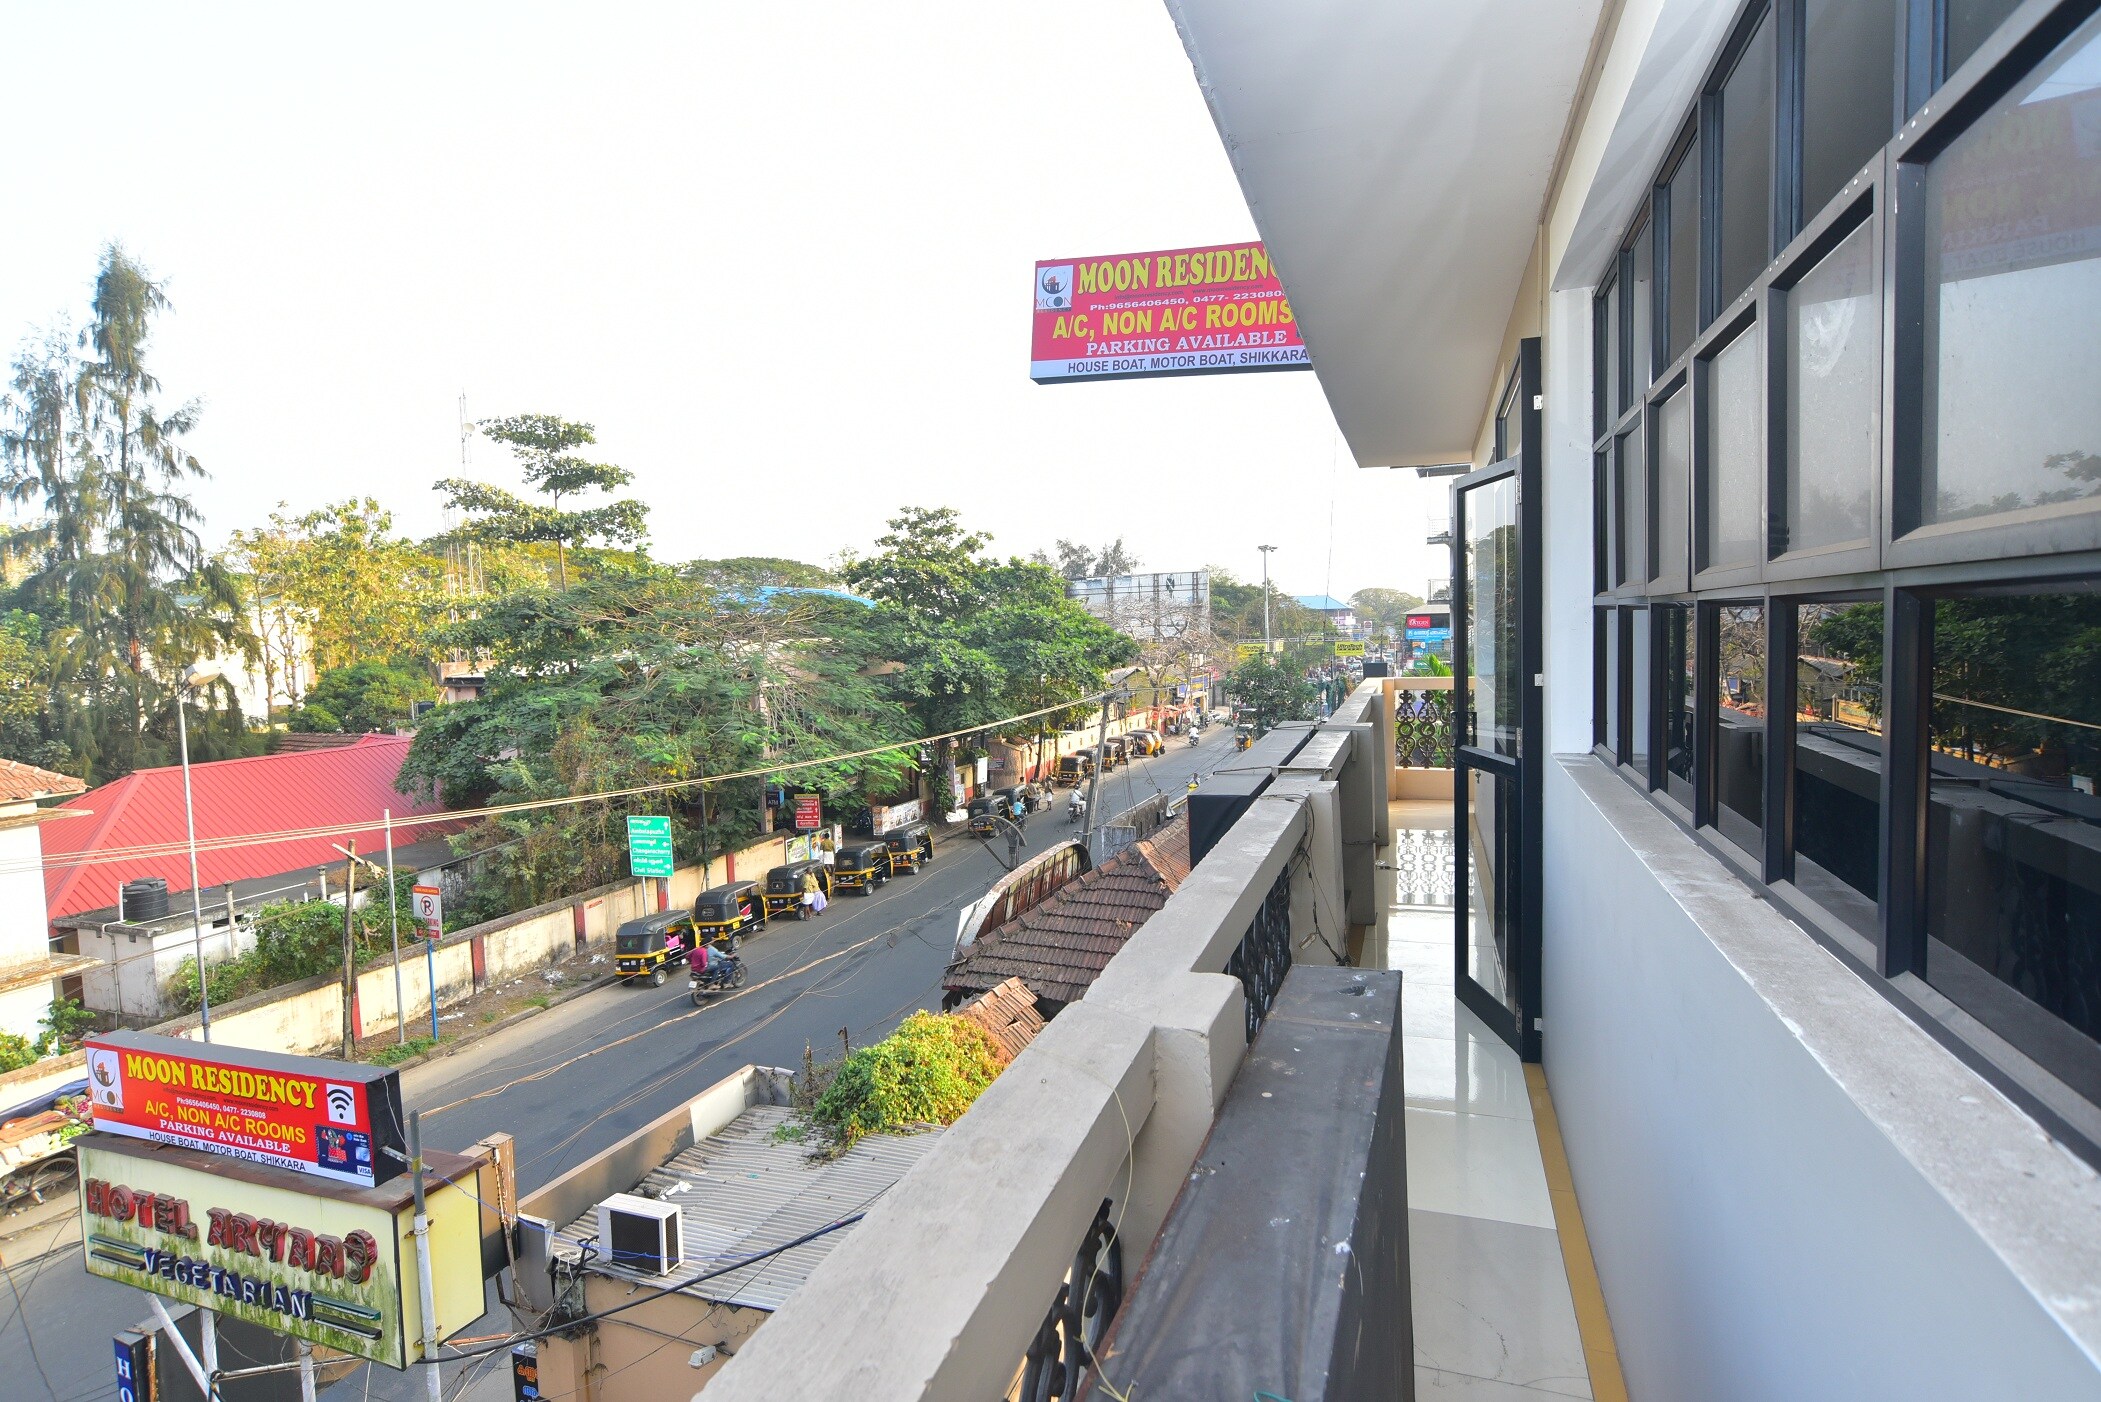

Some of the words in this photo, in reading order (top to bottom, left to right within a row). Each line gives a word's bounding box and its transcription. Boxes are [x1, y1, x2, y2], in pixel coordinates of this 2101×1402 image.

[1077, 257, 1151, 294] MOON
[1052, 314, 1095, 342] A/C,
[1103, 309, 1153, 336] NON
[1158, 306, 1198, 332] A/C
[1205, 299, 1295, 329] ROOMS
[1068, 360, 1109, 373] HOUSE
[1112, 358, 1147, 371] BOAT,
[1150, 355, 1196, 369] MOTOR
[1200, 353, 1236, 366] BOAT,
[1239, 349, 1309, 364] SHIKKARA
[1086, 337, 1171, 356] PARKING
[1175, 330, 1287, 350] AVAILABLE
[126, 1053, 186, 1087] MOON
[189, 1063, 317, 1109] RESIDENCY
[145, 1099, 175, 1120] A/C,
[177, 1105, 209, 1126] NON
[214, 1112, 241, 1131] A/C
[245, 1118, 306, 1144] ROOMS
[159, 1119, 215, 1138] PARKING
[218, 1131, 291, 1153] AVAILABLE
[149, 1131, 176, 1145] HOUSE
[202, 1141, 232, 1156] MOTOR
[260, 1153, 307, 1172] SHIKKARA
[358, 1166, 372, 1175] VISA
[84, 1177, 199, 1241] HOTEL
[143, 1247, 314, 1321] VEGETARIAN
